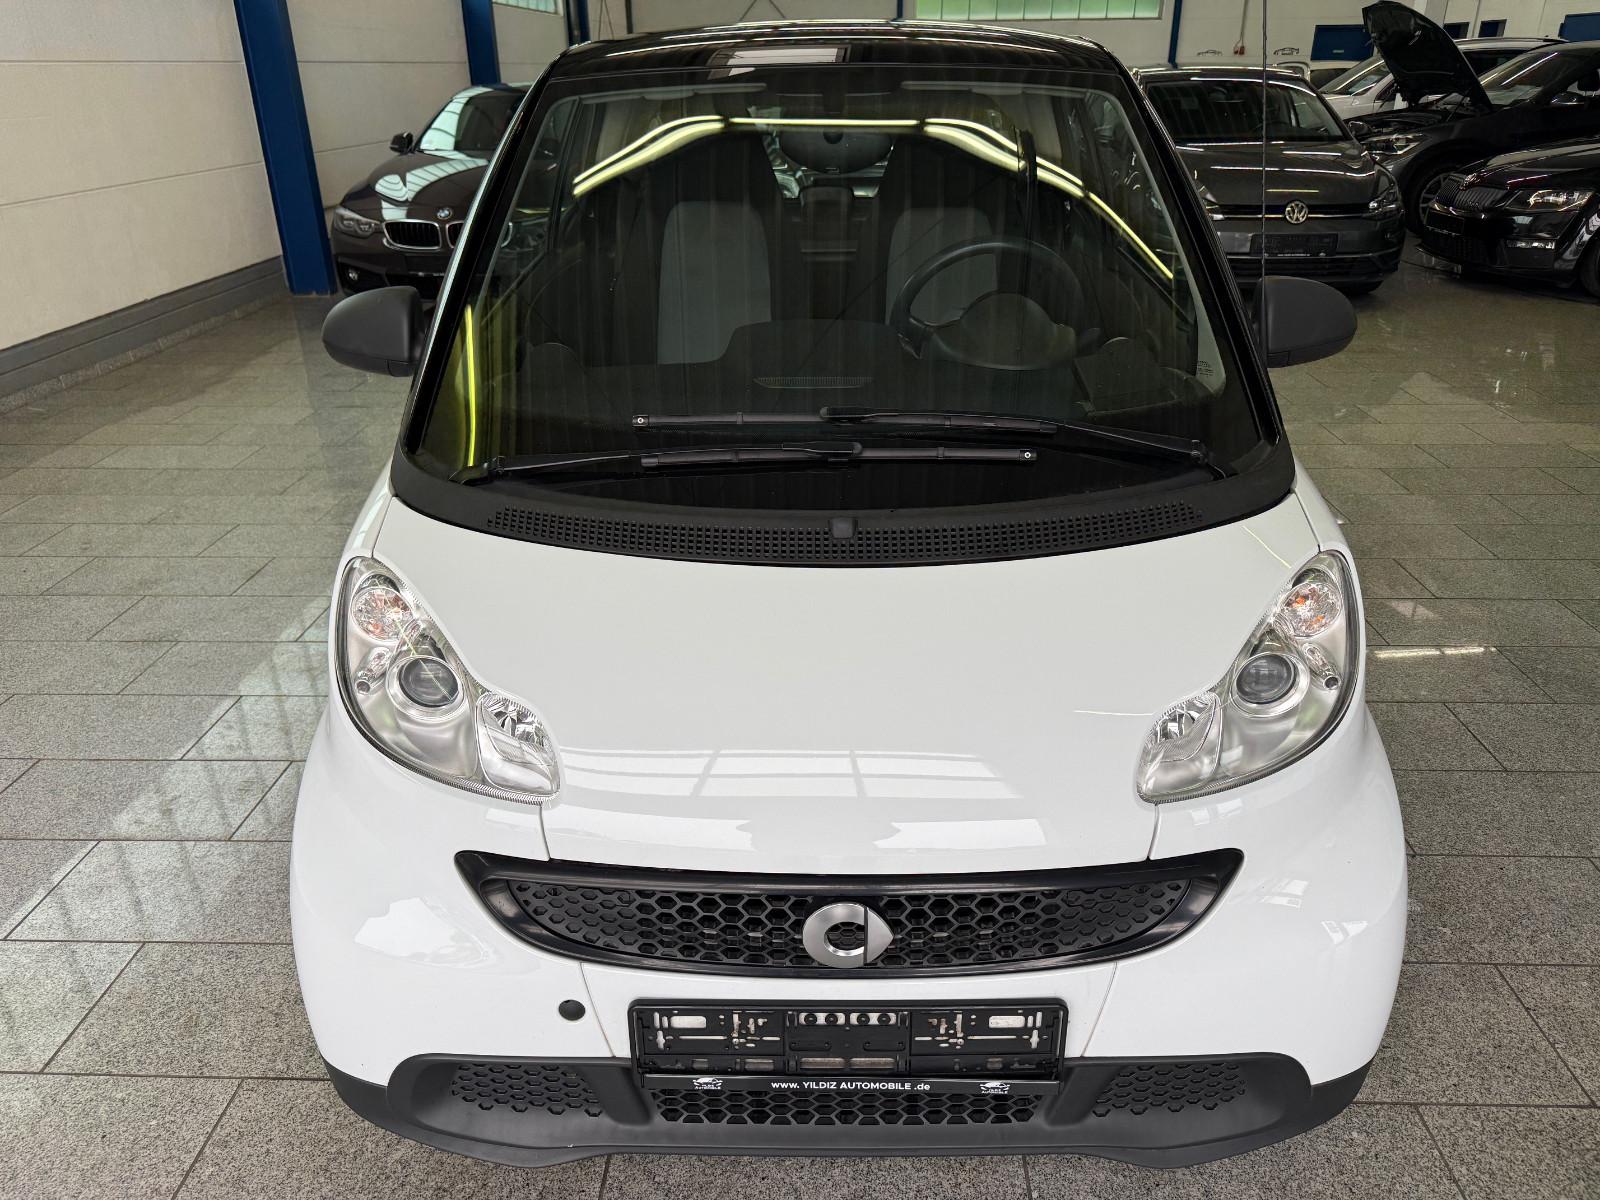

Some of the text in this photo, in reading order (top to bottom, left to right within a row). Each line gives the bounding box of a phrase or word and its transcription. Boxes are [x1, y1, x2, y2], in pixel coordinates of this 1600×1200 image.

[771, 1081, 931, 1091] www. YILDIZ AUTOMOBILE .de
